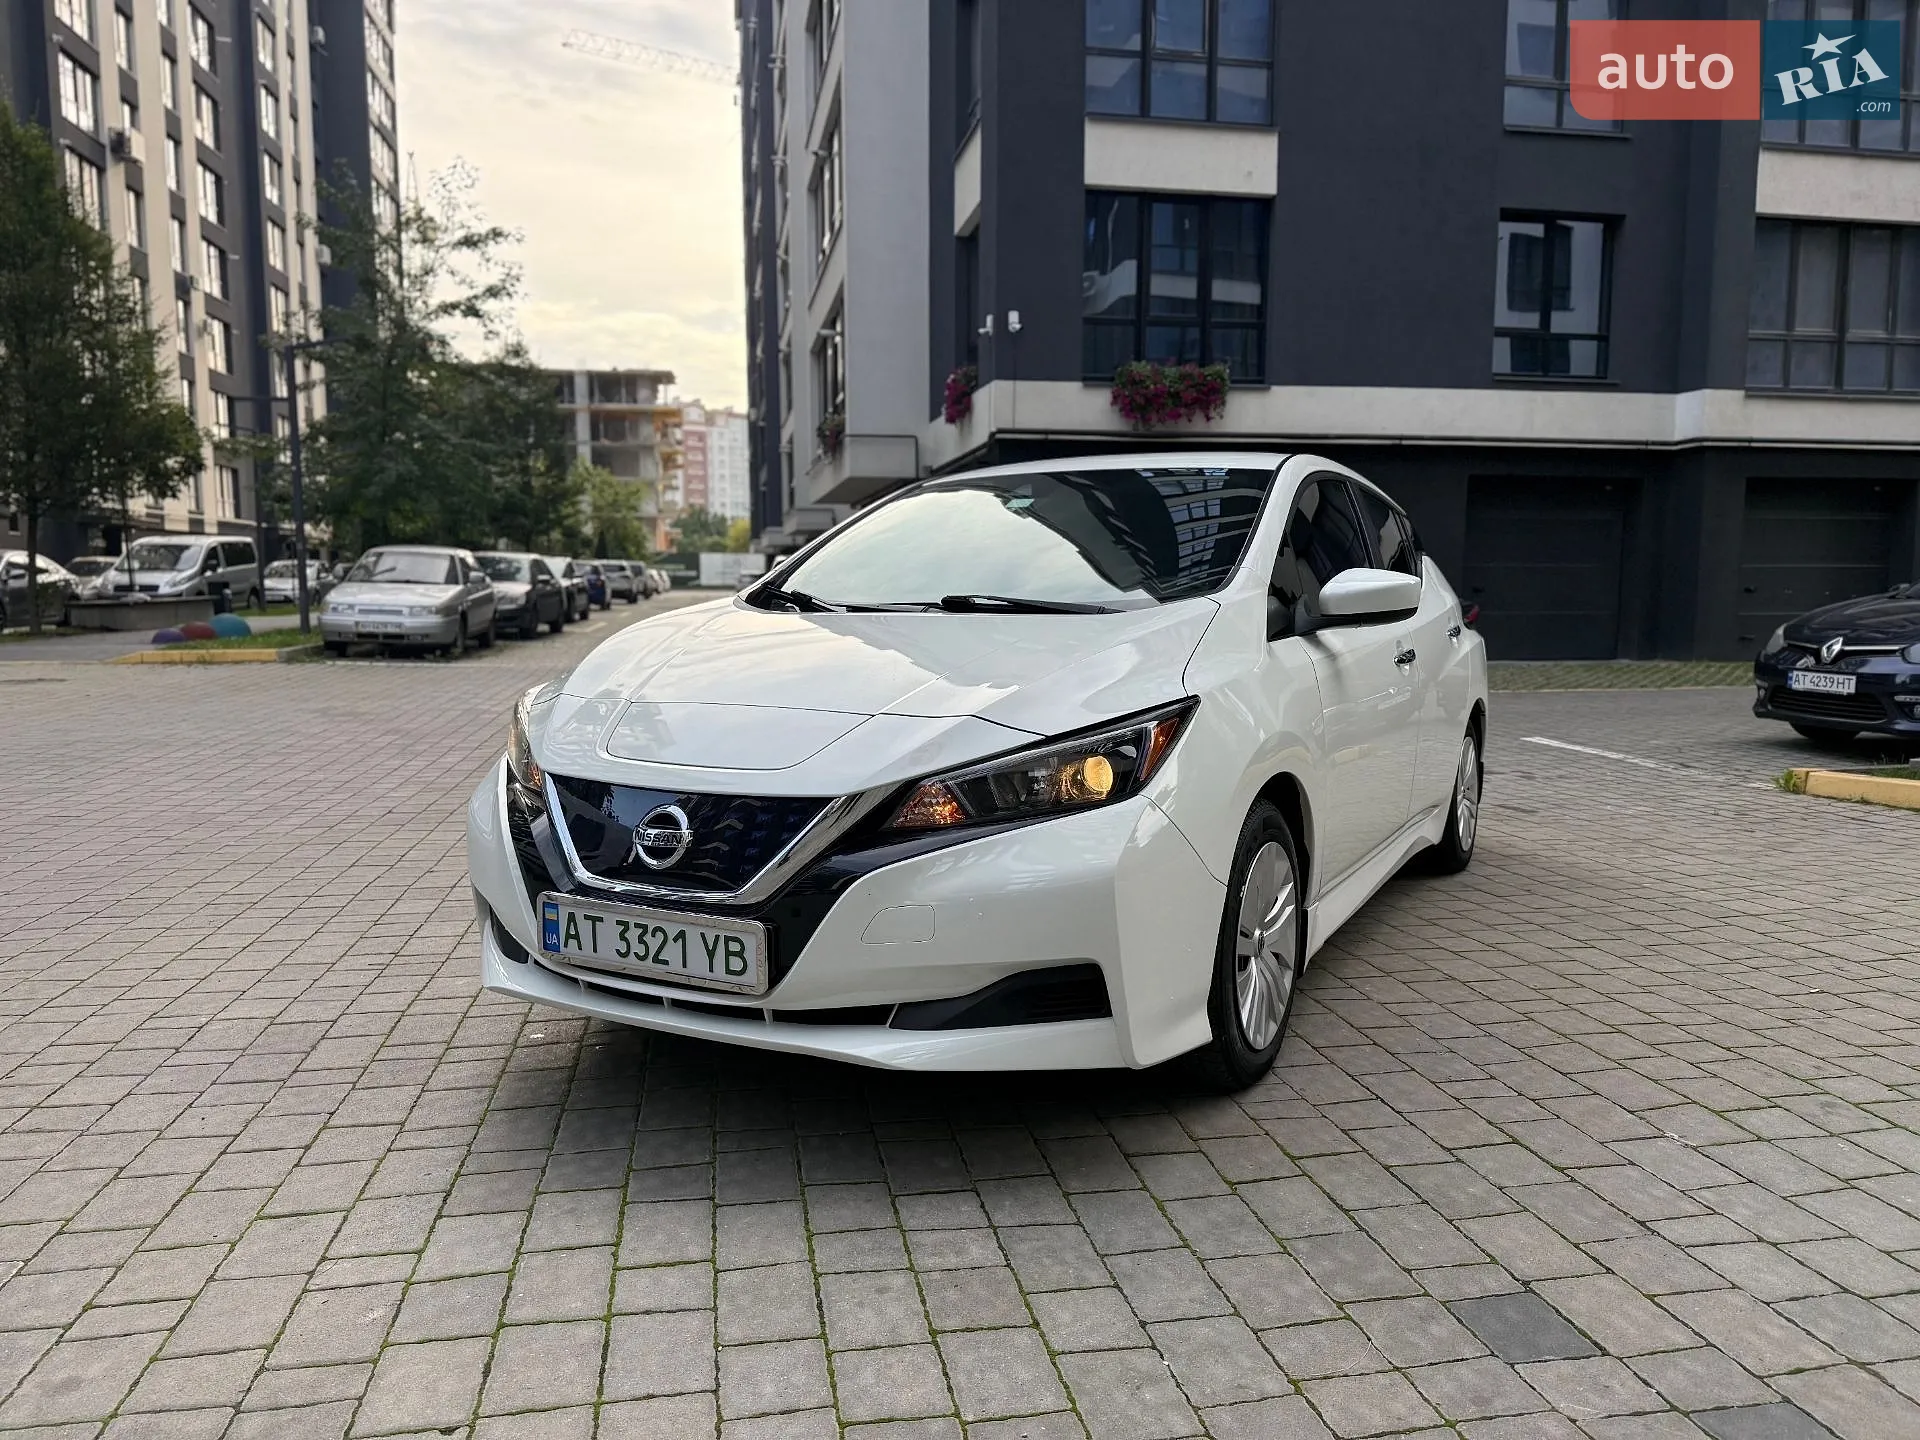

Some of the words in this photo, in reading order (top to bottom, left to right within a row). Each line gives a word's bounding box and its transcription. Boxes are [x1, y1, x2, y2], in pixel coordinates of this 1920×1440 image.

[1793, 673, 1809, 686] AT
[1809, 675, 1835, 689] 4239
[1836, 677, 1854, 690] HT
[635, 828, 682, 844] NISSAN
[545, 931, 559, 946] UA
[563, 911, 604, 954] AT
[615, 919, 688, 969] 3321
[700, 932, 748, 976] YB
